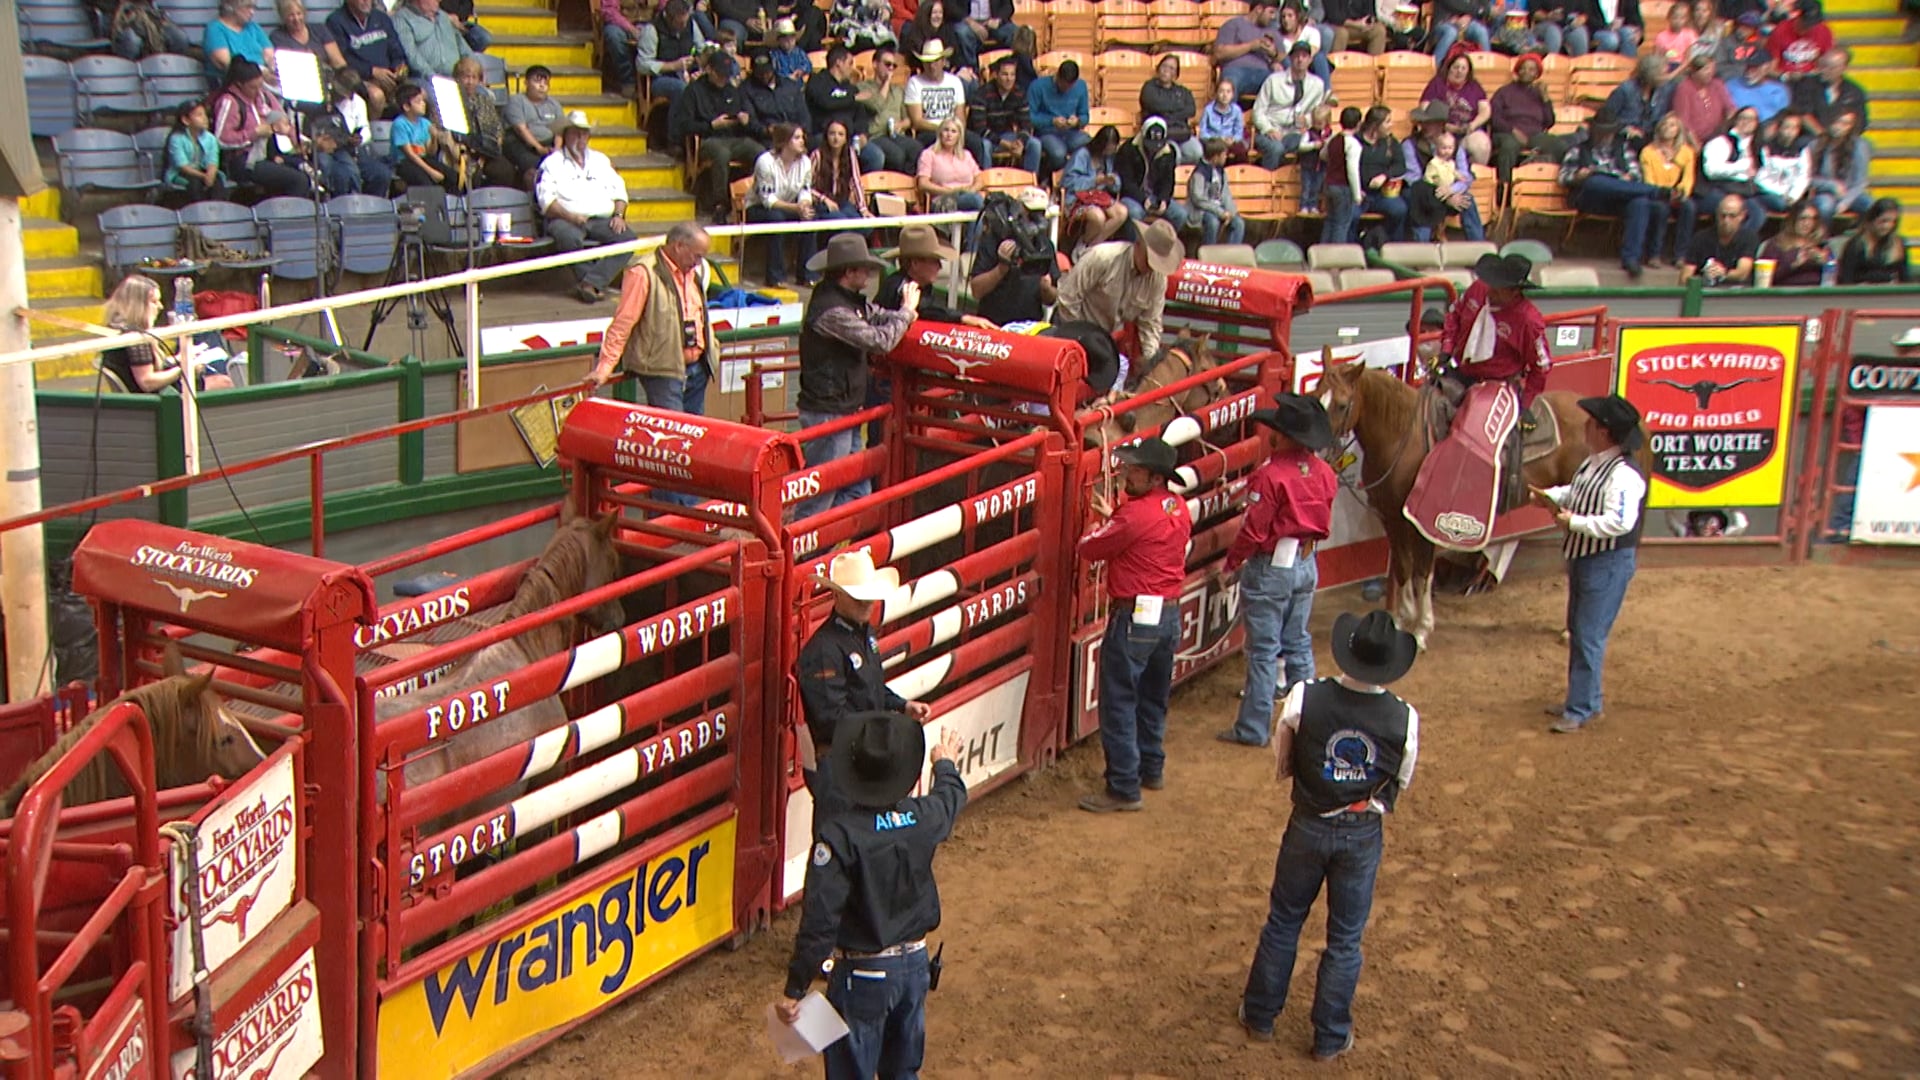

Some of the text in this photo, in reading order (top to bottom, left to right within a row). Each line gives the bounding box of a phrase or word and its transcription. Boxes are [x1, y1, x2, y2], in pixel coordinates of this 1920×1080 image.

[1179, 281, 1242, 299] RODEO
[919, 331, 1013, 360] STOCKYARDS
[1636, 353, 1781, 373] STOCKYARDS
[625, 411, 708, 439] STOCKYARDS
[1209, 394, 1256, 431] WORTH
[1646, 409, 1762, 427] PRO RODEO
[616, 439, 692, 467] RODEO
[1650, 436, 1687, 453] ORT
[1664, 455, 1737, 472] TEXAS
[973, 478, 1036, 524] WORTH
[176, 541, 233, 562] Fort Worth
[130, 545, 259, 588] STOCKYARDS
[966, 580, 1027, 628] YARDS
[427, 597, 727, 739] FORT WORTH
[1333, 767, 1367, 782] UPRA
[409, 711, 727, 887] STOCK YARDS
[212, 793, 267, 856] Fort Worth
[423, 840, 710, 1038] Wrangler
